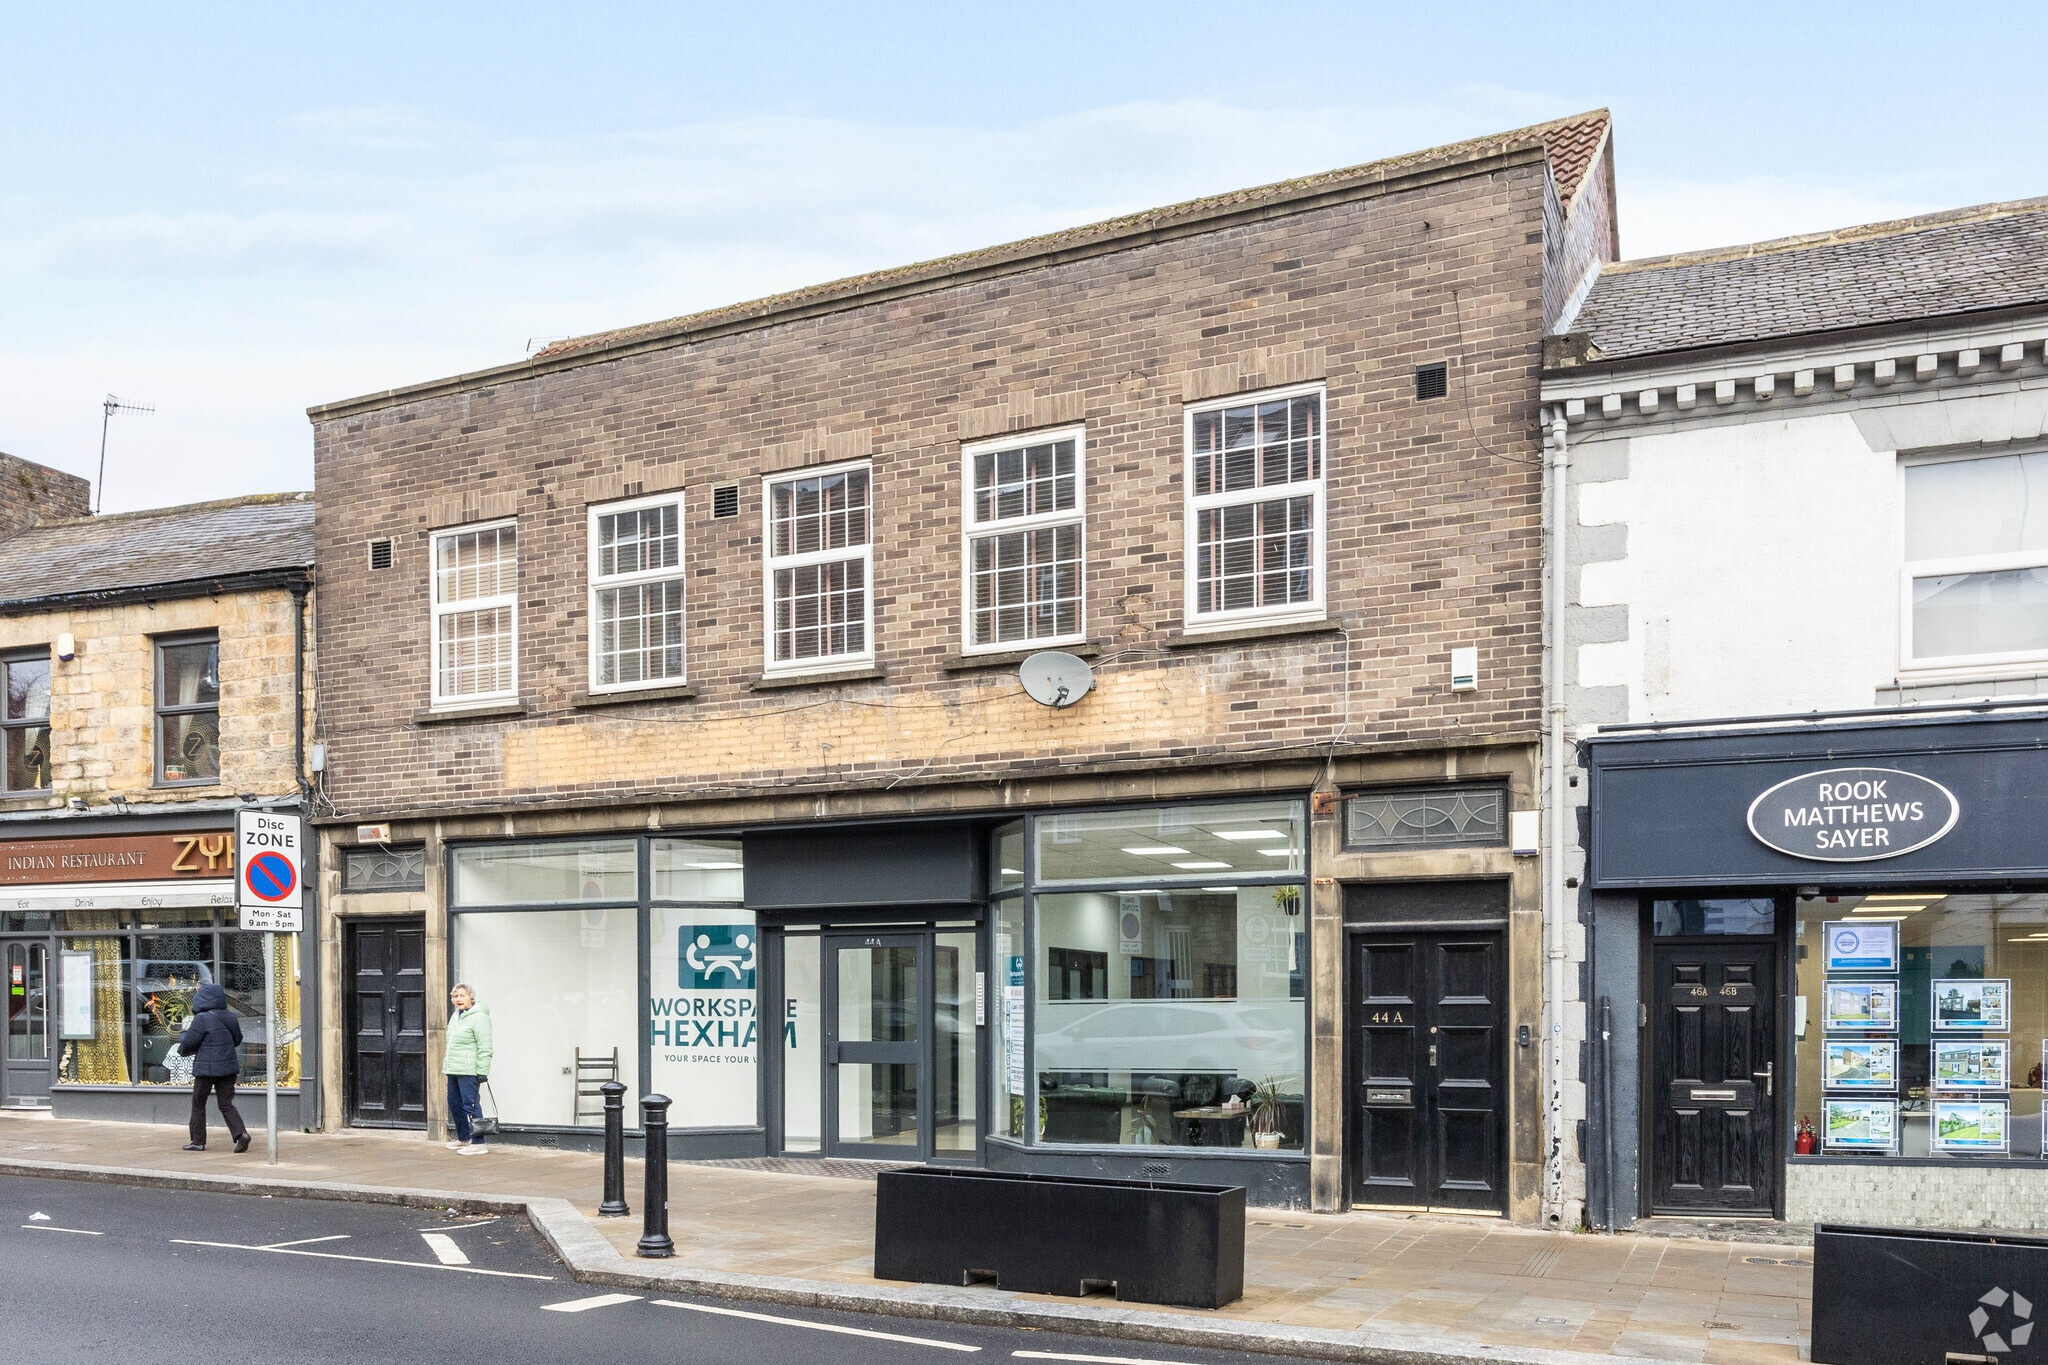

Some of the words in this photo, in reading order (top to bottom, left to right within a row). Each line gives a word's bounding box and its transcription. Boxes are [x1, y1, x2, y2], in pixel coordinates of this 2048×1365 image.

[1819, 780, 1887, 802] ROOK
[1784, 802, 1924, 827] MATTHEWS
[258, 818, 285, 830] Disc
[246, 832, 294, 848] ZONE
[1816, 827, 1889, 849] SAYER
[7, 855, 55, 870] INDIAN
[61, 850, 146, 868] RESTAURANT
[17, 900, 30, 909] Eat
[74, 898, 94, 908] Drink
[142, 896, 163, 906] Enjoy
[210, 894, 233, 905] Relax
[252, 910, 270, 918] Mon
[277, 910, 291, 919] Sat
[248, 919, 254, 927] 9
[275, 920, 280, 928] 5
[281, 921, 295, 929] pm
[1690, 987, 1708, 996] 46A
[1719, 987, 1737, 996] 46B
[651, 998, 797, 1018] WORKSPE
[1372, 1011, 1389, 1023] 44
[1393, 1011, 1403, 1023] A
[664, 1054, 689, 1063] YOUR
[691, 1054, 721, 1063] SPACE
[724, 1055, 750, 1064] YOUR
